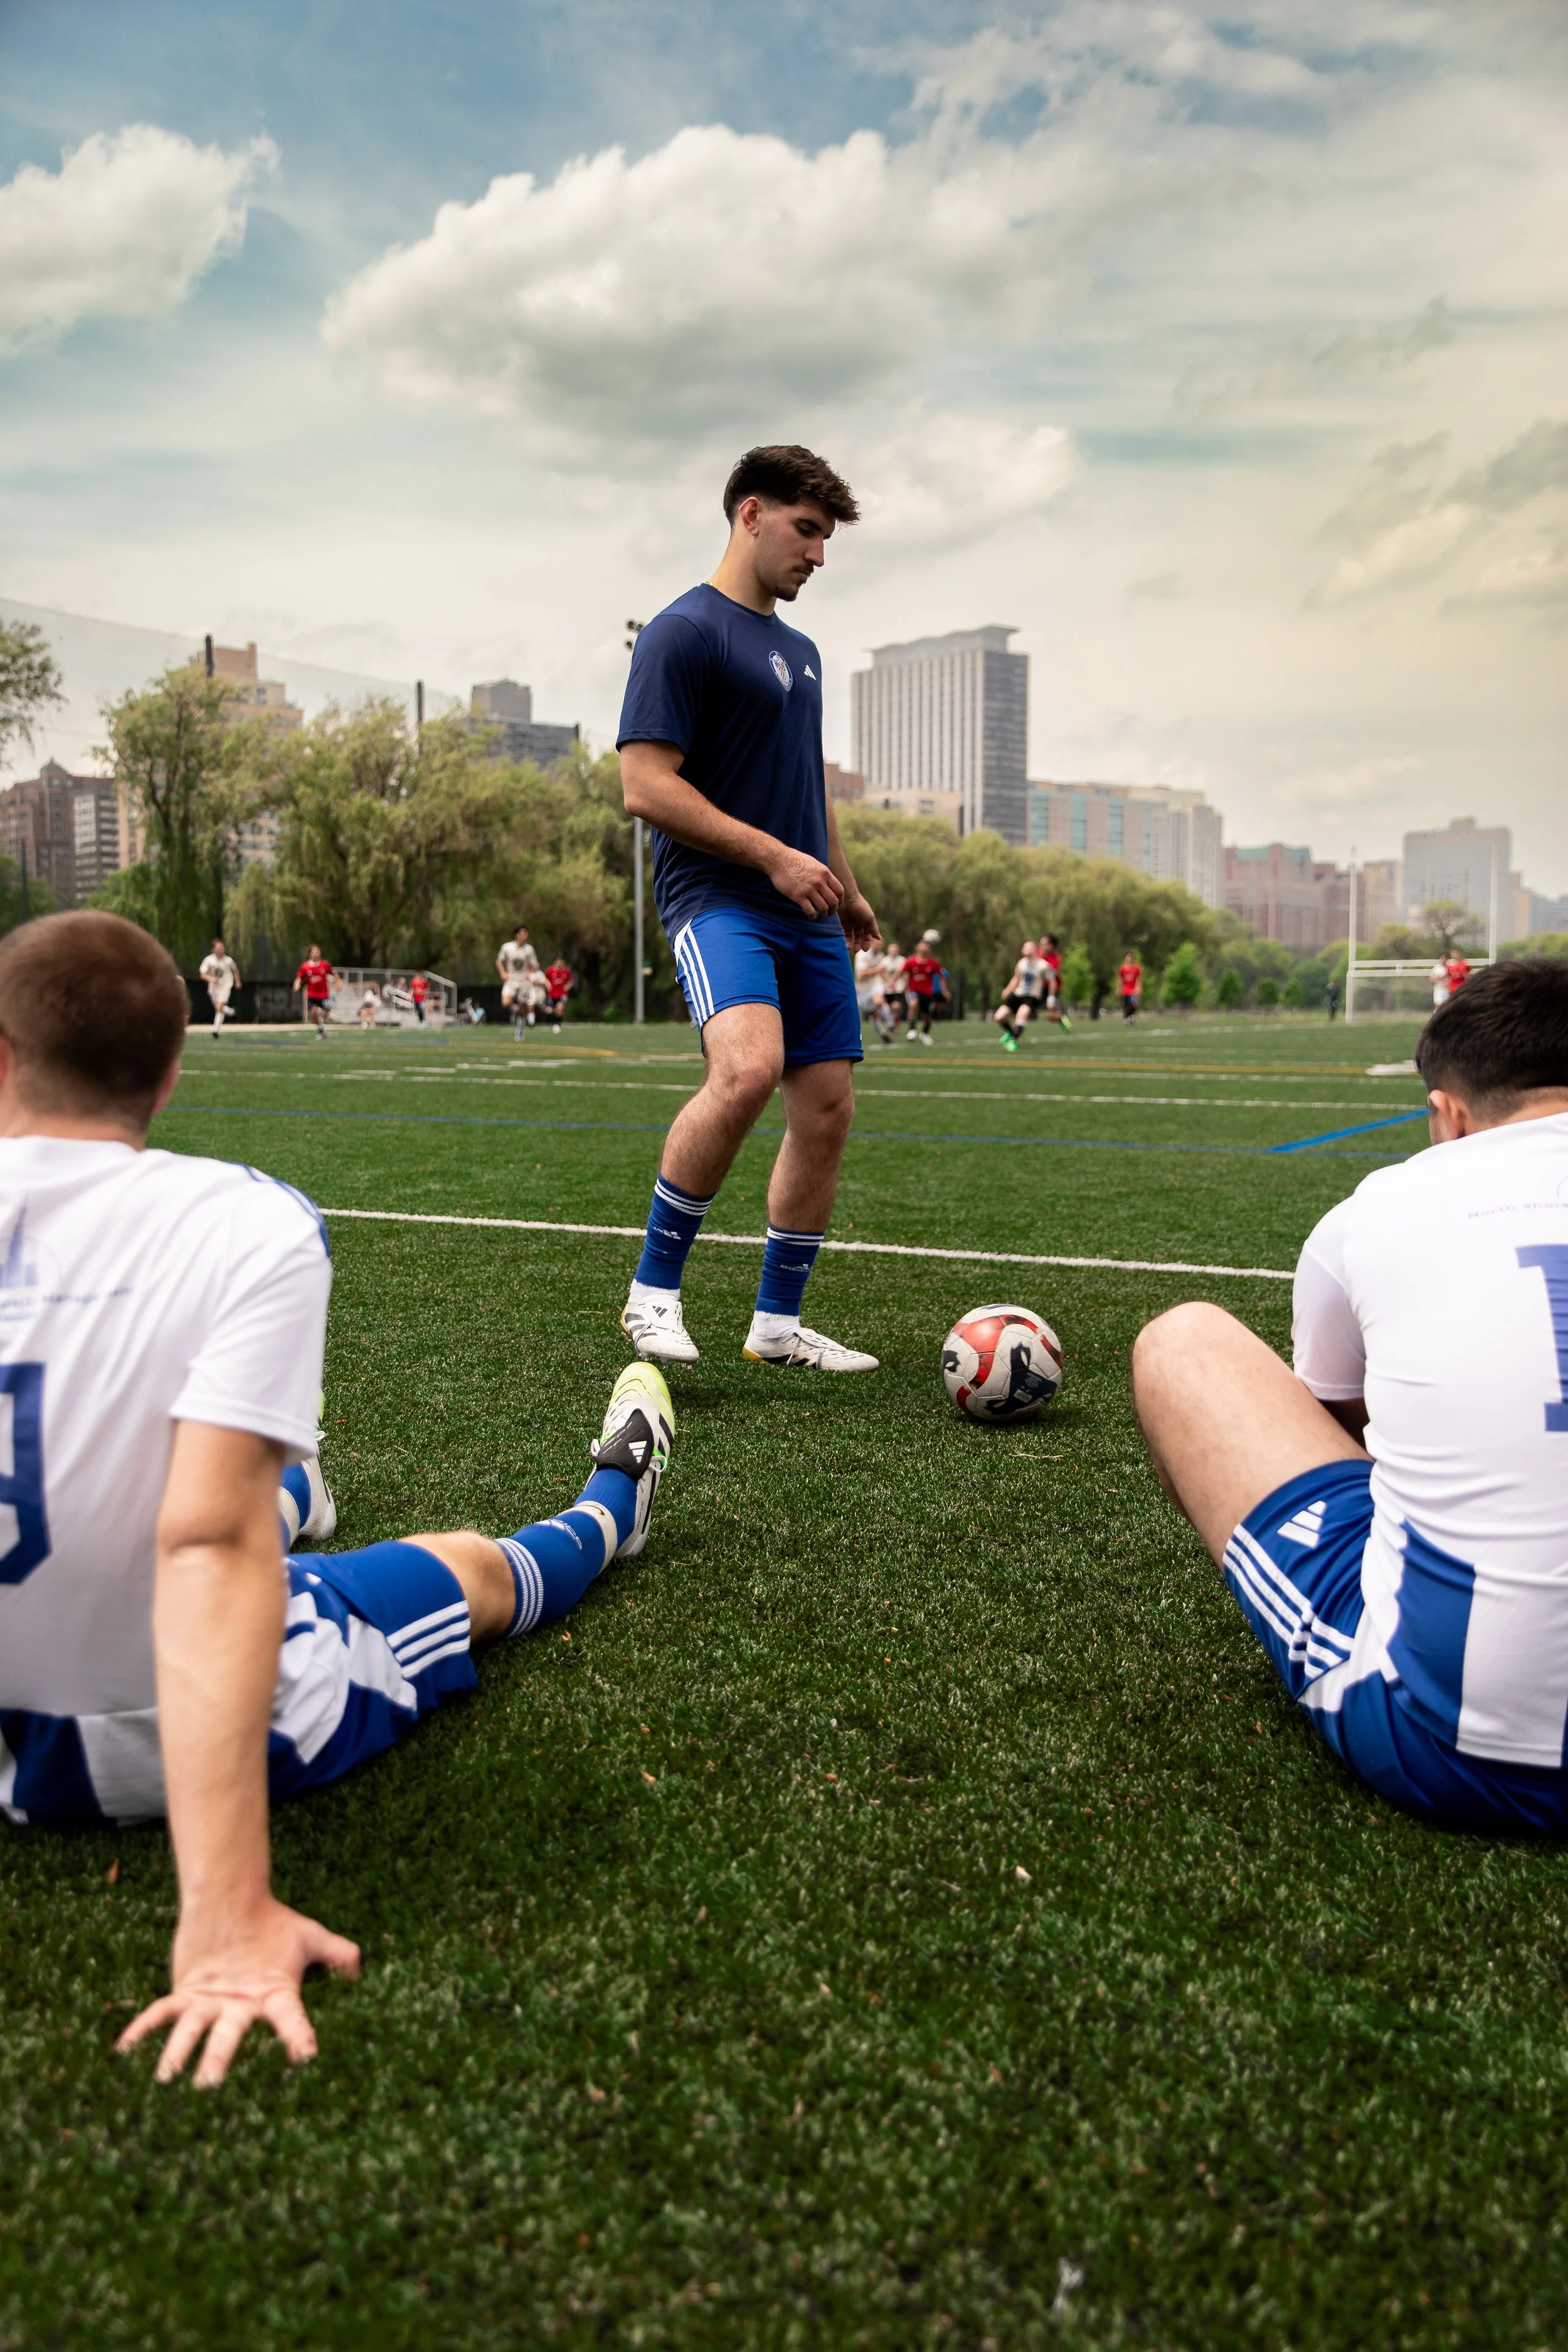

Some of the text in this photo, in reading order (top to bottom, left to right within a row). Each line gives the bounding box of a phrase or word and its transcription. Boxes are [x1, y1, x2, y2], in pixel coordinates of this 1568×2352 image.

[1468, 1200, 1568, 1219] North Shore
[780, 1263, 810, 1273] adida
